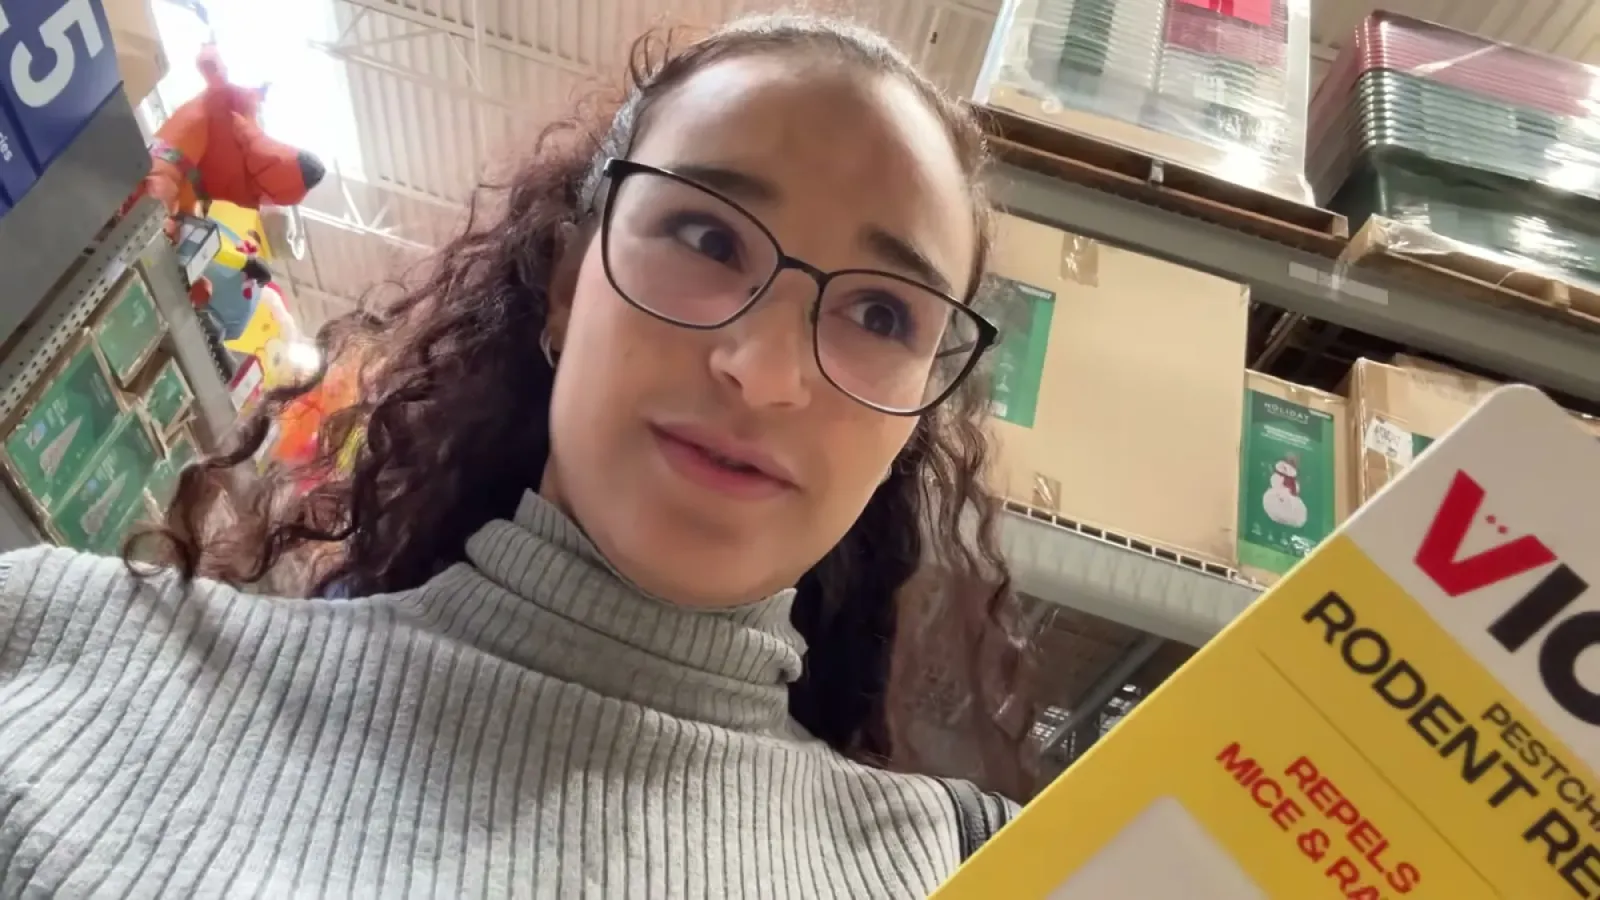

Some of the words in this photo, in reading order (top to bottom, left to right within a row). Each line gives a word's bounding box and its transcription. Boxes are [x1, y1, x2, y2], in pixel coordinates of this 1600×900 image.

[0, 0, 104, 107] 5
[1302, 590, 1539, 808] RODENT
[1215, 742, 1305, 832] MICE
[1296, 828, 1331, 863] &
[1284, 755, 1421, 894] REPELS
